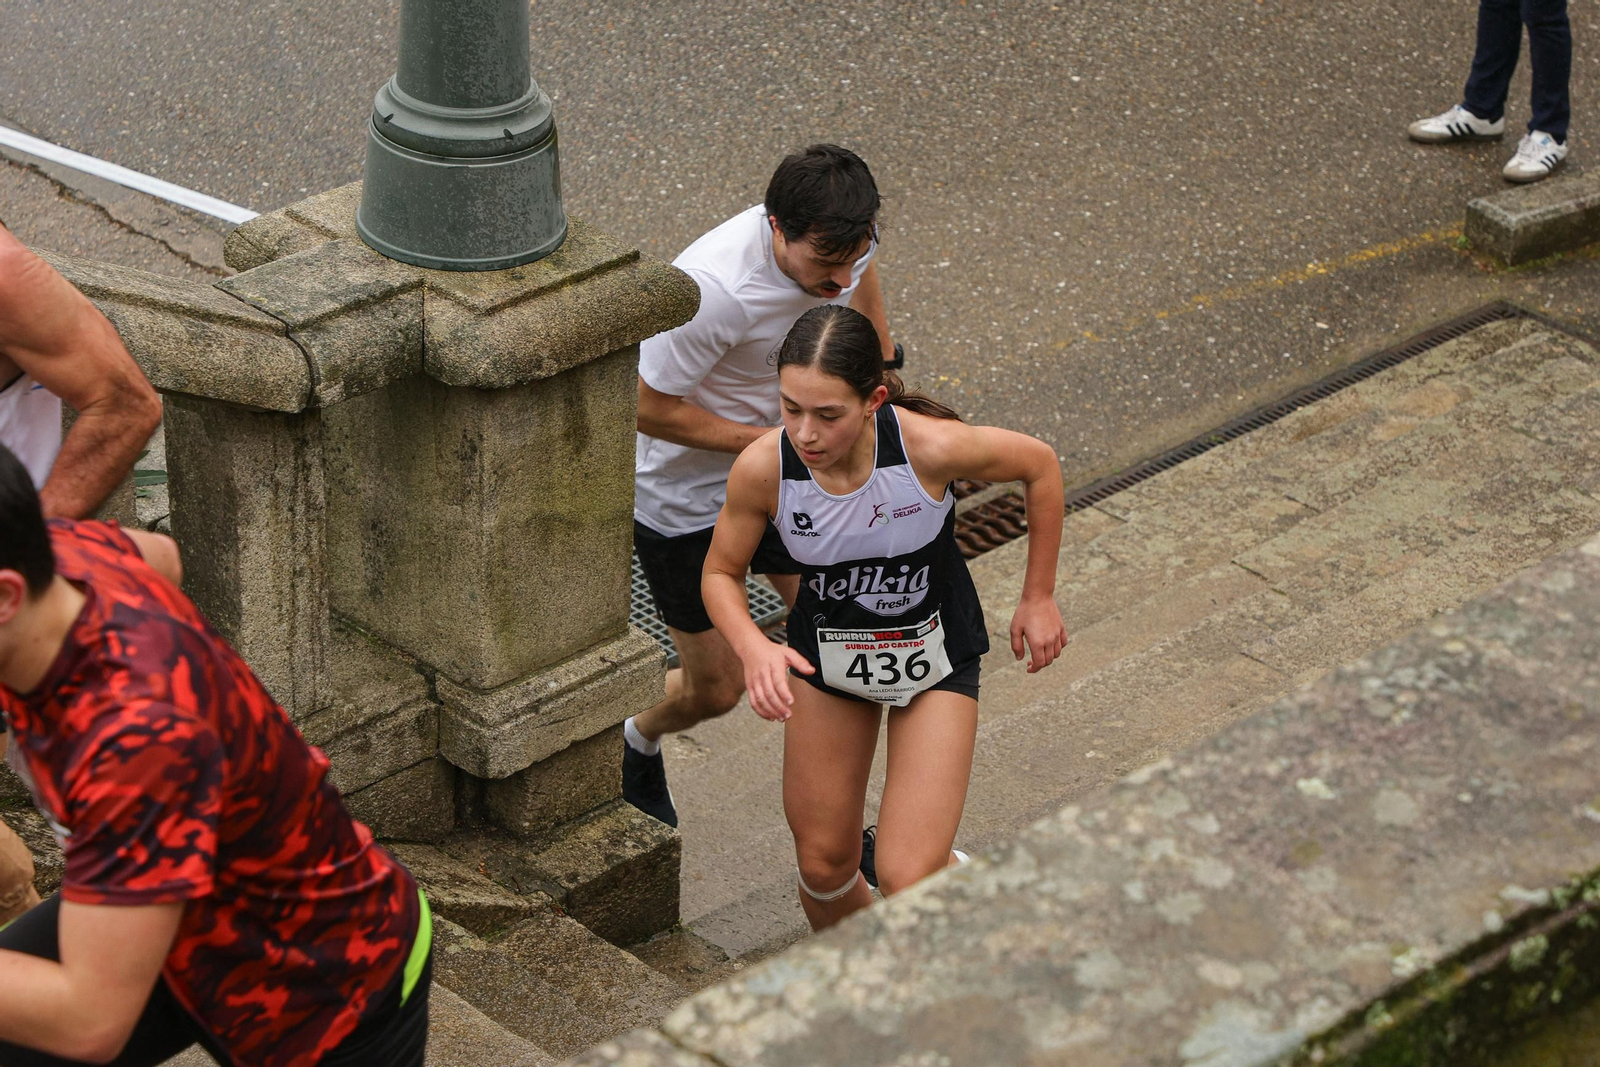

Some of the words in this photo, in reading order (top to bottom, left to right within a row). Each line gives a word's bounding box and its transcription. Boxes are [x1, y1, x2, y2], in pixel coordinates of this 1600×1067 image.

[893, 506, 922, 519] DELIKIA
[808, 565, 930, 601] delikia
[875, 595, 910, 610] fresh
[845, 643, 876, 651] SUBIDA
[891, 639, 925, 649] CASTRO
[845, 649, 931, 686] 436
